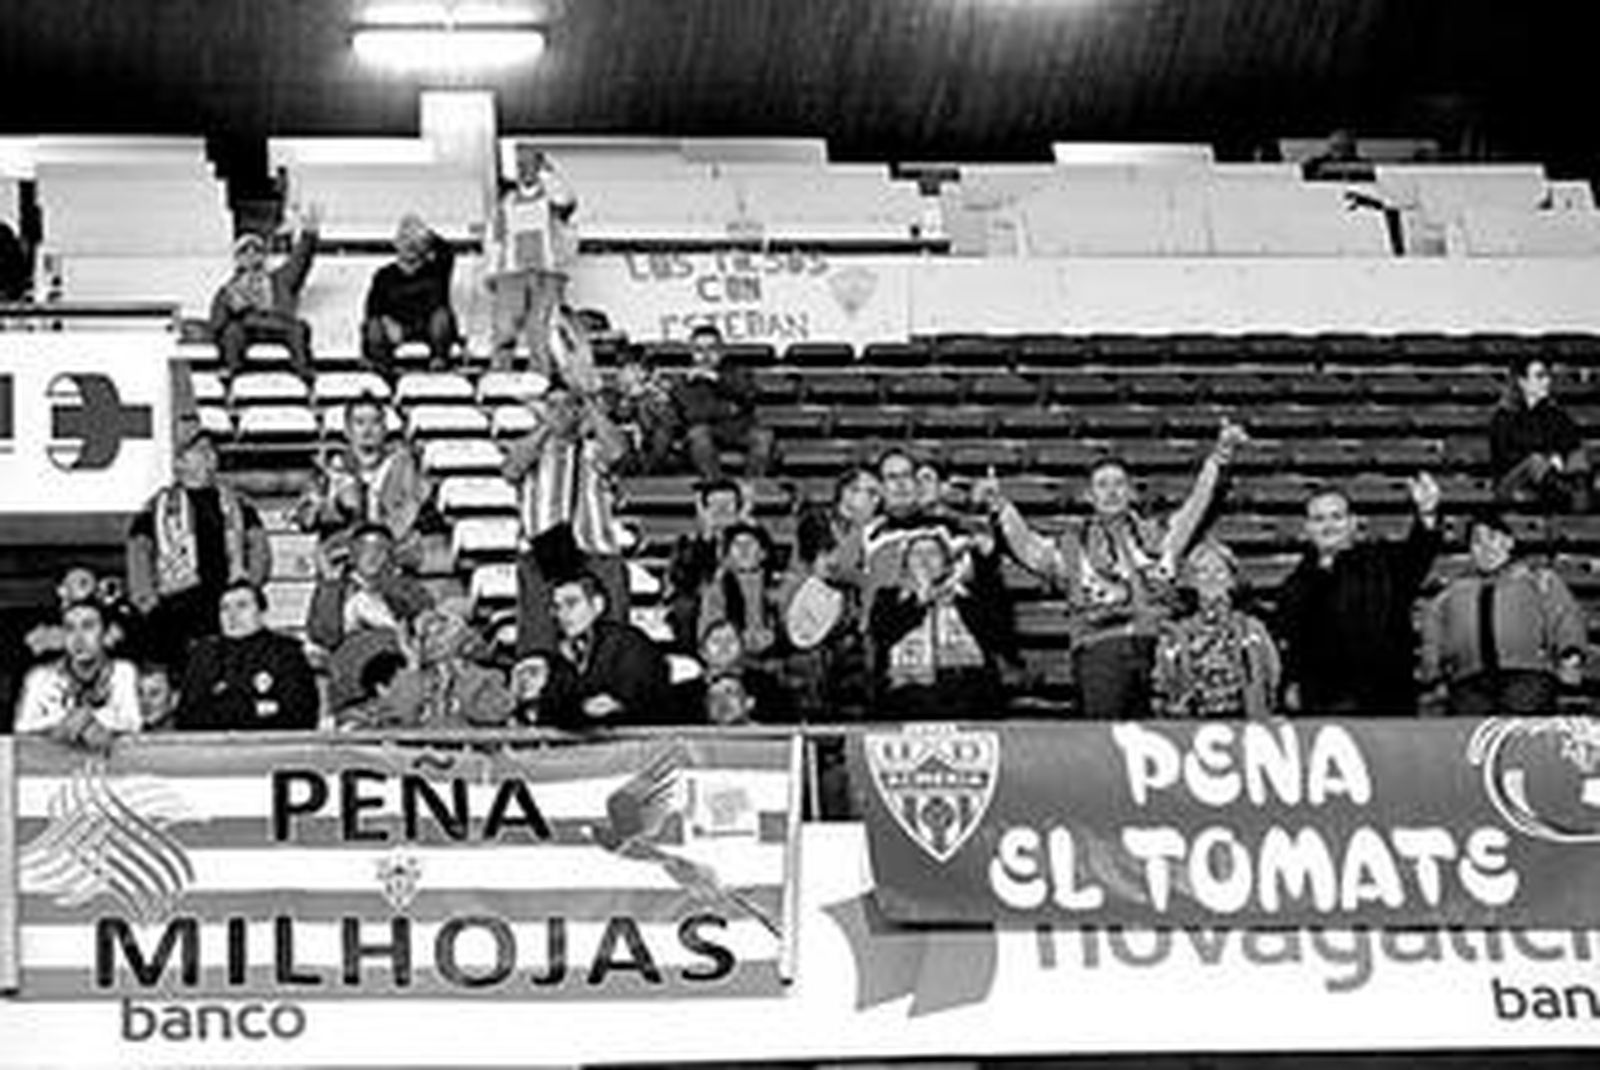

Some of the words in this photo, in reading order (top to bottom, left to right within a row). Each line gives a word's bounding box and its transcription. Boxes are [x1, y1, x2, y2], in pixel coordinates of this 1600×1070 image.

[697, 275, 762, 302] CON
[272, 754, 553, 843] PEÑA
[988, 826, 1104, 910] EL
[1121, 826, 1519, 913] TOMATE
[95, 912, 737, 990] MILHOJAS
[121, 999, 306, 1041] banco
